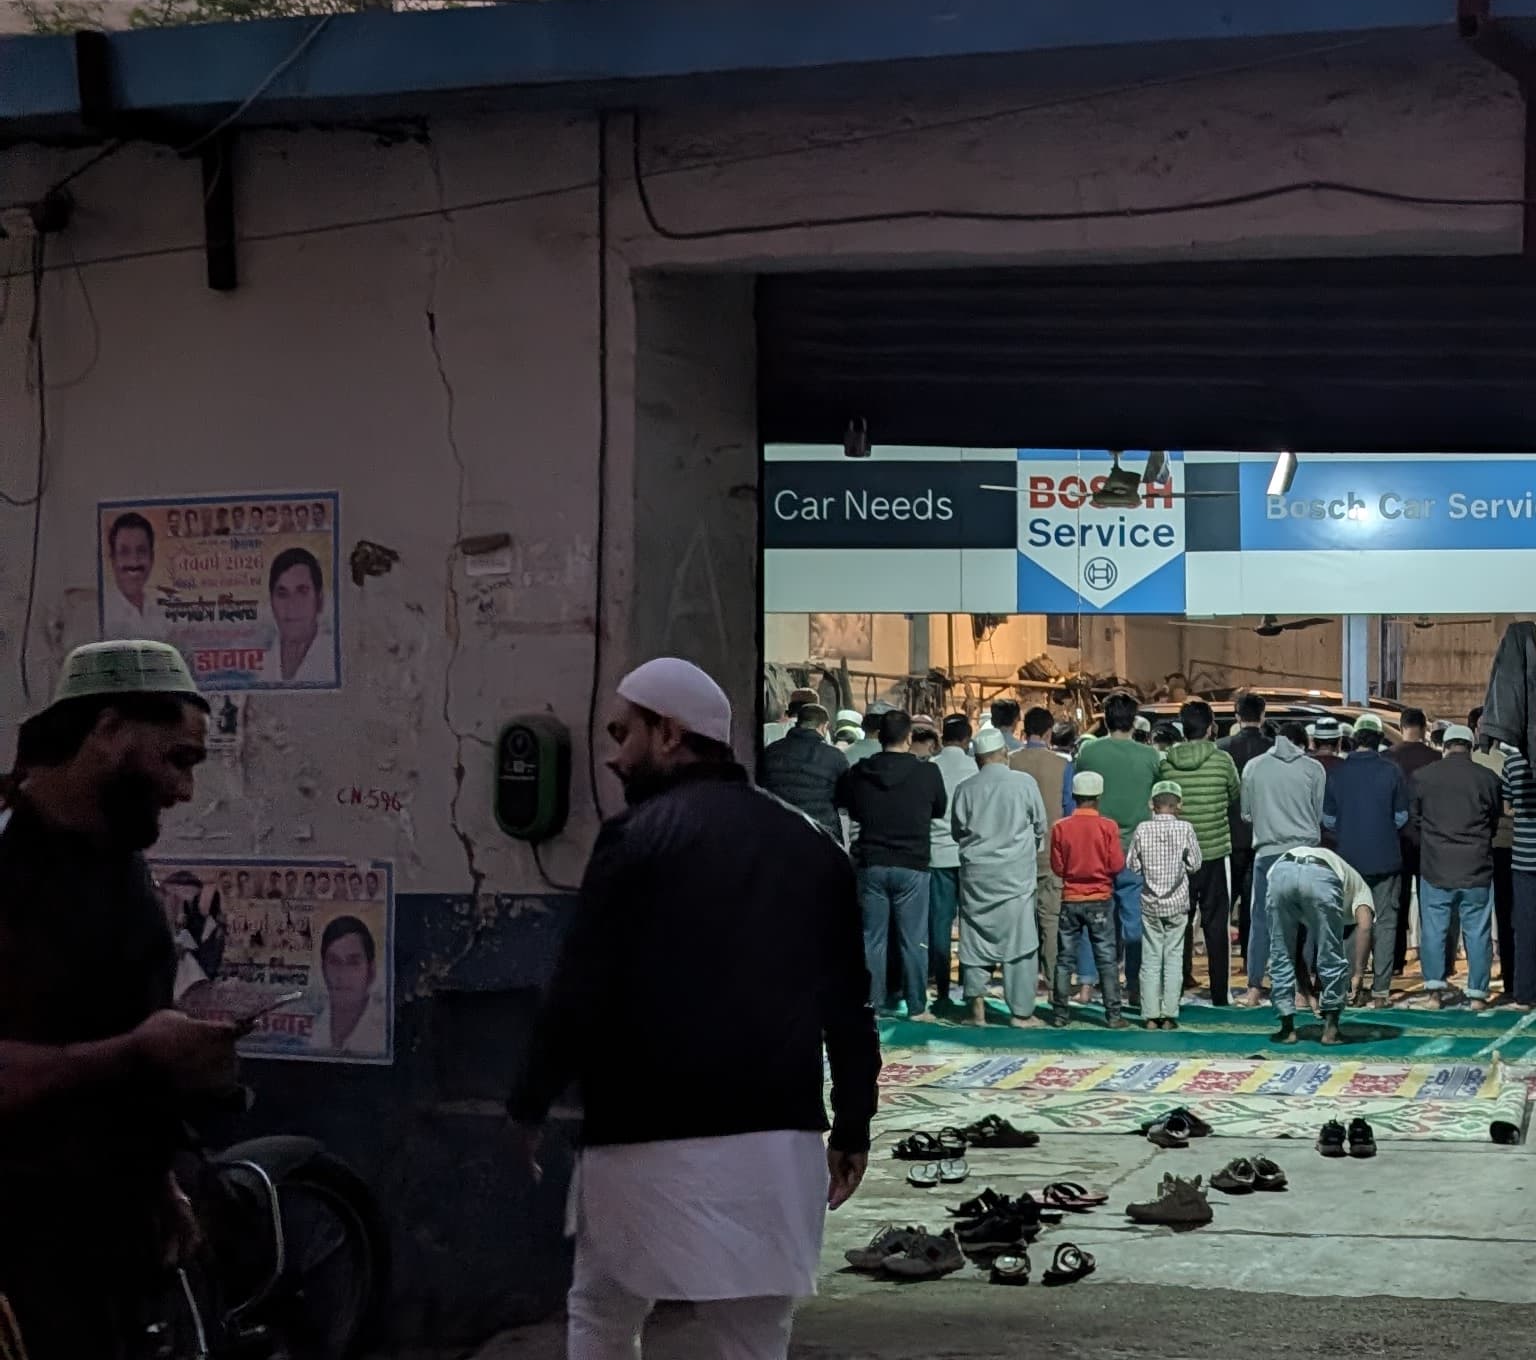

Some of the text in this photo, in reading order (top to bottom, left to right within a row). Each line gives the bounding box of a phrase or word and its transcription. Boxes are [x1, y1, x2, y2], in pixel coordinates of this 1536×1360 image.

[774, 488, 953, 521] Car Needs
[1029, 476, 1173, 509] BOH
[1267, 492, 1368, 521] Bosch
[1379, 492, 1436, 520] Car
[1028, 516, 1175, 548] Service
